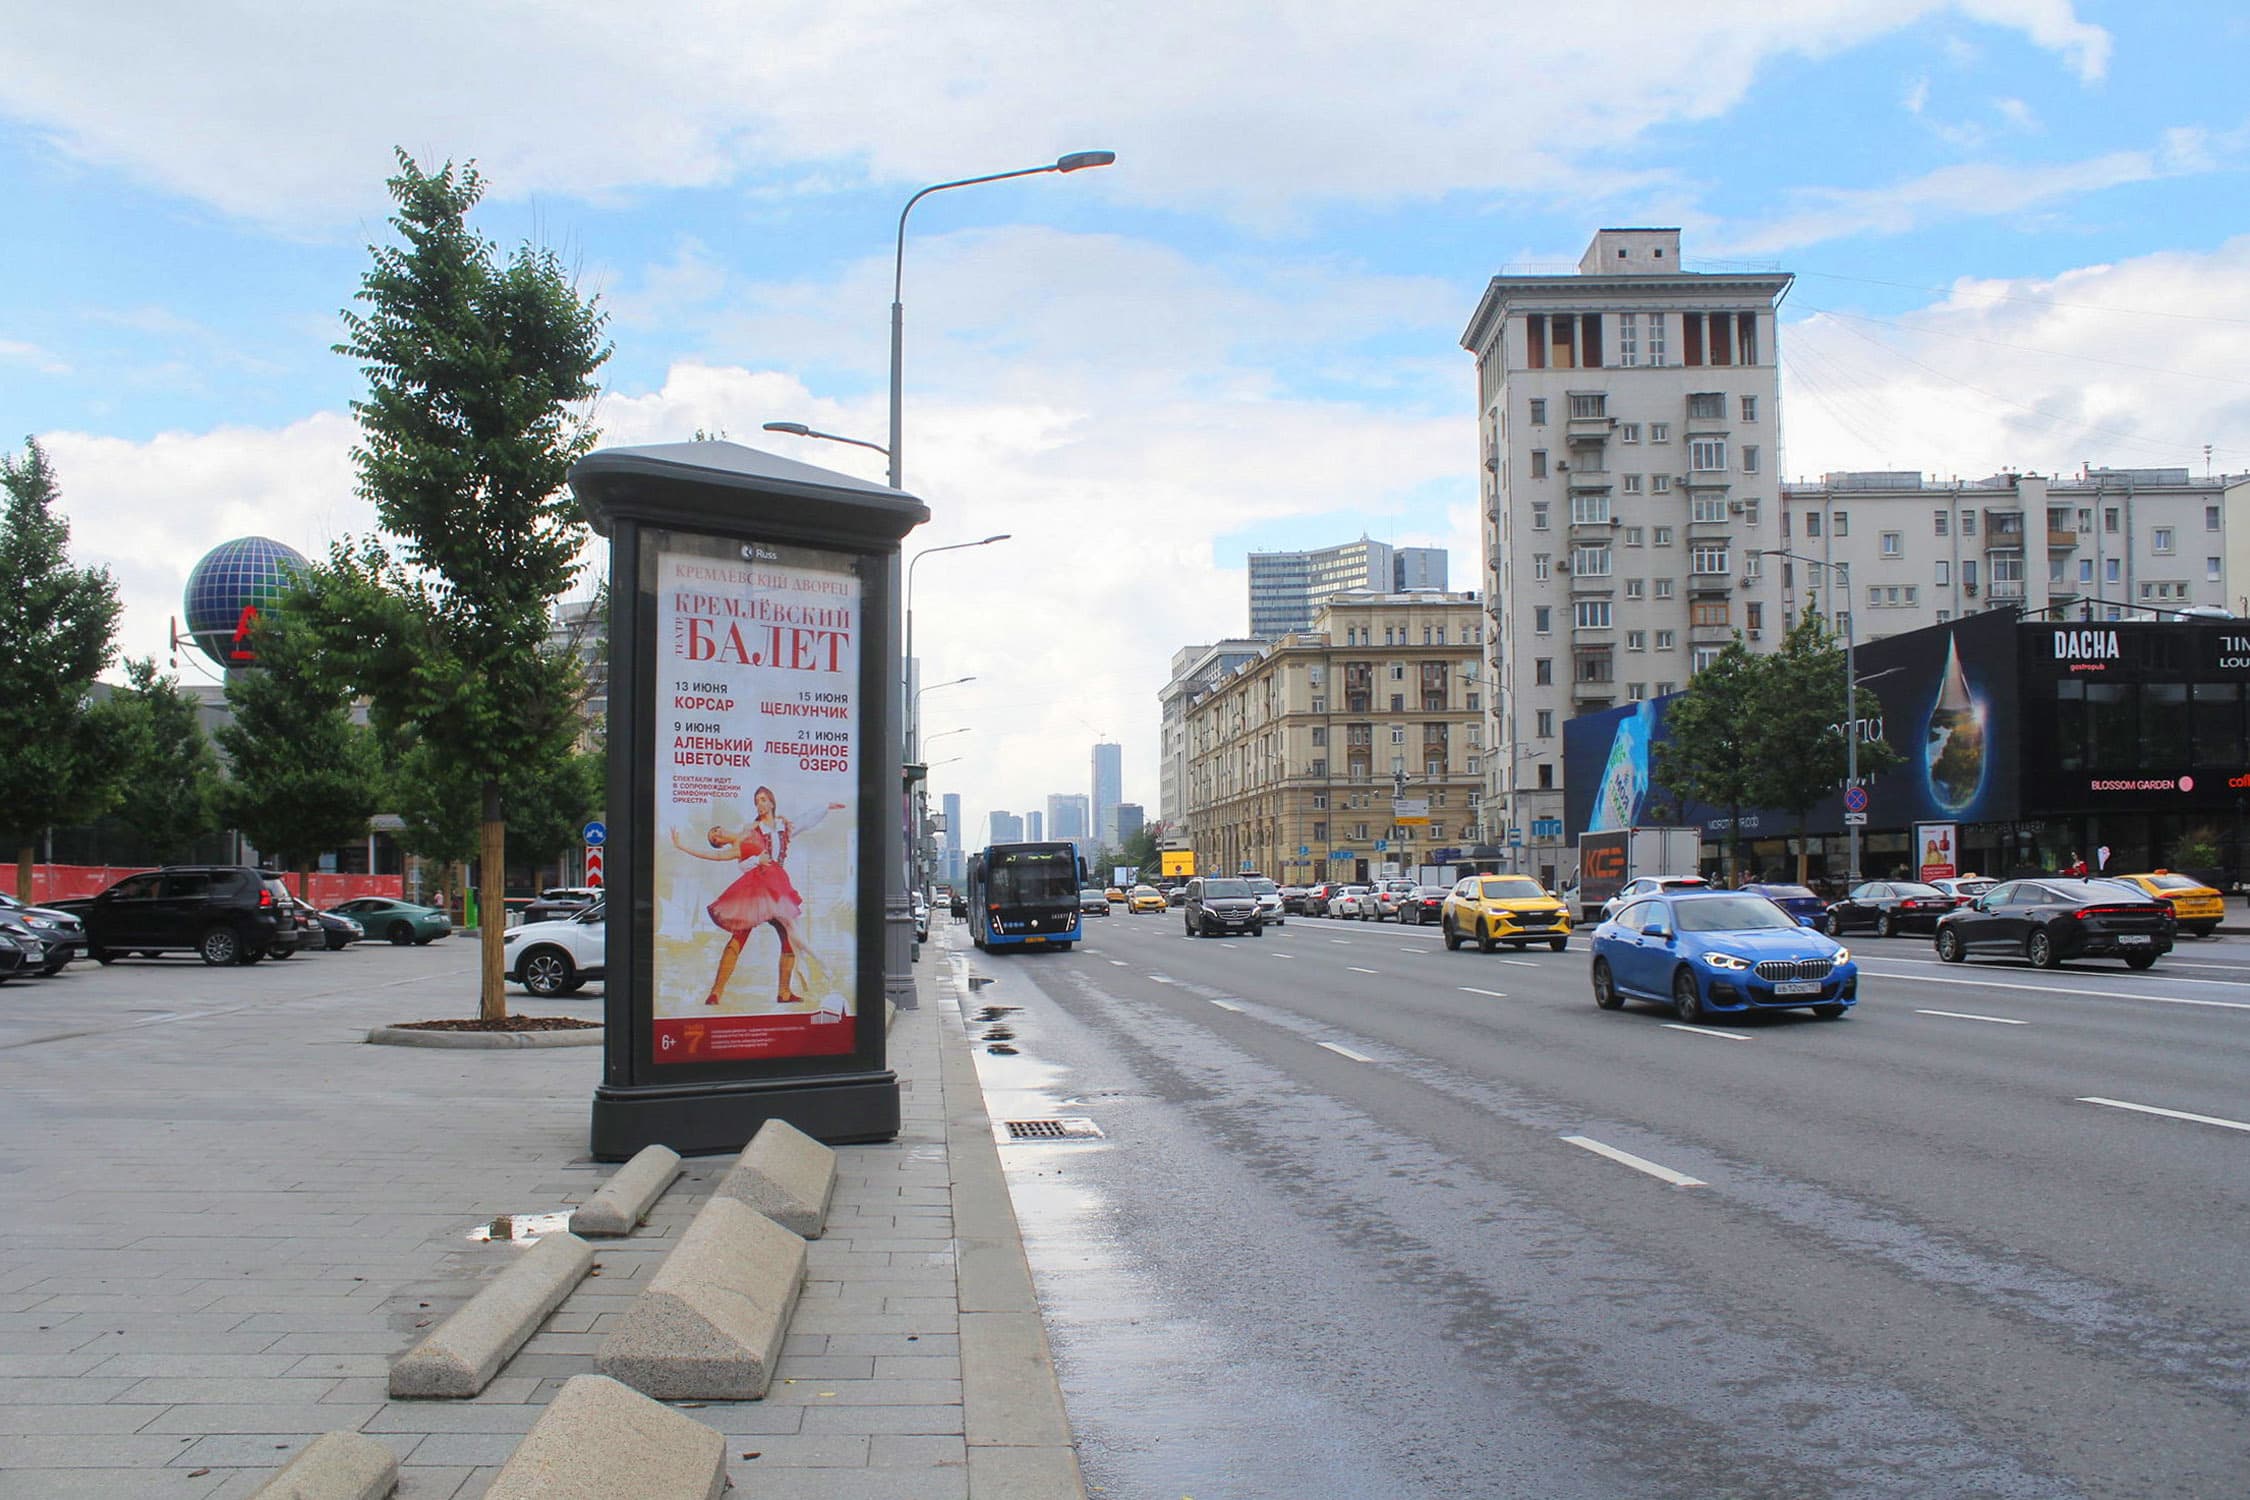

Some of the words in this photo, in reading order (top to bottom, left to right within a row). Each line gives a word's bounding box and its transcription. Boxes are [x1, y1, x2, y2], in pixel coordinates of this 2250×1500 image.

[792, 578, 849, 596] ДВОРЕЦ
[675, 592, 850, 629] КРЕМЛЁВСКИЙ
[684, 617, 850, 673] БАЛЕТ
[2054, 630, 2120, 659] DACHA
[675, 681, 689, 692] 13
[692, 682, 728, 694] ИЮНЯ
[674, 696, 735, 711] КОРСАР
[799, 691, 811, 702] 15
[815, 692, 848, 704] ИЮНЯ
[760, 701, 848, 719] ЩЕЛКУНЧИК
[674, 721, 682, 732] 9
[685, 722, 721, 733] ИЮНЯ
[674, 736, 753, 752] АЛЕНЬКИЙ
[798, 730, 810, 740] 21
[815, 731, 848, 742] ИЮНЯ
[764, 741, 849, 758] ЛЕБЕДИНОЕ
[674, 751, 751, 768] ЦВЕТОЧЕК
[799, 758, 848, 772] ОЗЕРО
[2091, 780, 2136, 791] BLOSSOM
[2137, 779, 2175, 790] GARDEN
[661, 1034, 677, 1051] 6+
